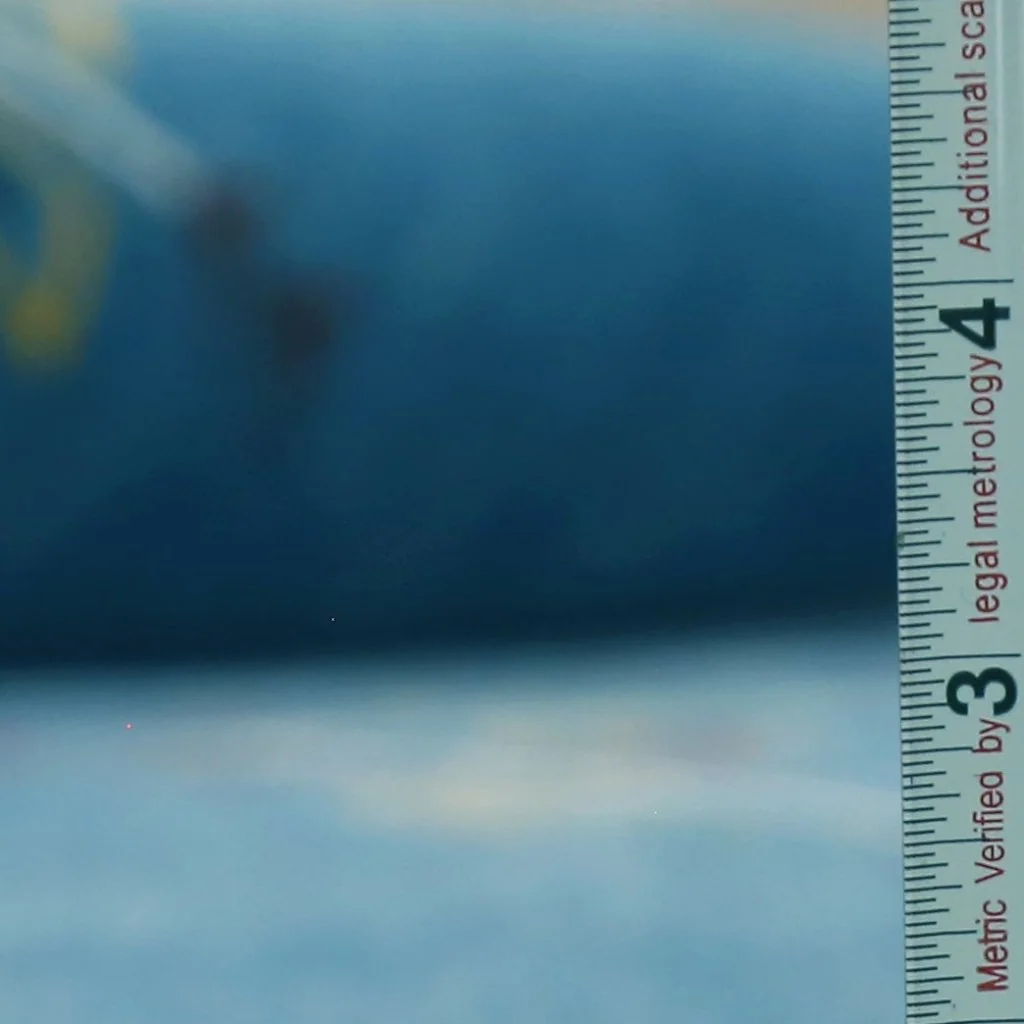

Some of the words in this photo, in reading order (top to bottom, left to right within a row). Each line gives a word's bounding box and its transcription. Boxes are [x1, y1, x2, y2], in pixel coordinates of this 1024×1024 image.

[954, 72, 991, 252] Additional
[938, 297, 1010, 351] 4
[963, 354, 1003, 529] metrology
[967, 540, 1008, 623] legal
[945, 667, 1018, 716] 3
[970, 718, 1010, 754] by
[972, 770, 1005, 884] Verified
[975, 898, 1010, 993] Metric
